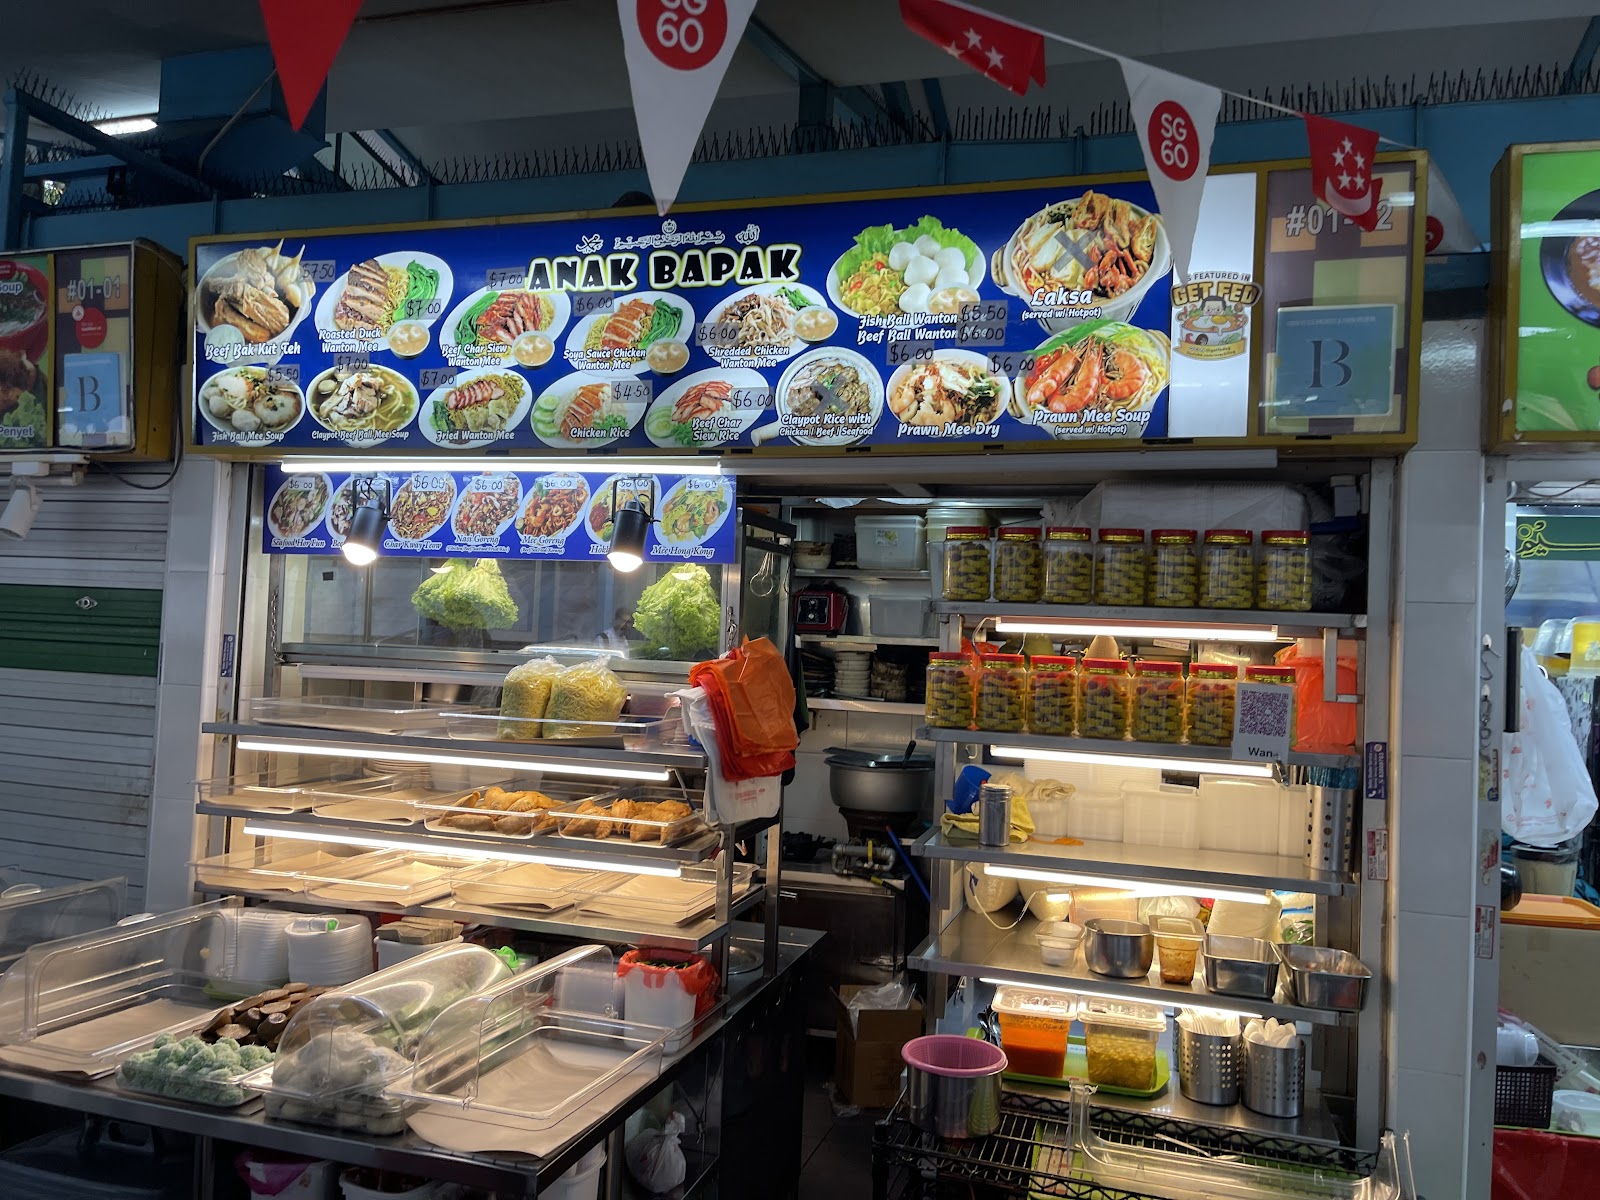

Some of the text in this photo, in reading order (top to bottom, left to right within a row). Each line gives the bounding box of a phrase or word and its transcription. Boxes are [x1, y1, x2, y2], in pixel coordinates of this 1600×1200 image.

[656, 10, 705, 54] 60
[1160, 112, 1187, 143] SG
[1160, 139, 1189, 169] 60
[1286, 199, 1394, 238] #01-2
[527, 247, 800, 292] ANAK BAPAK
[1194, 272, 1239, 281] FEATURED
[1240, 273, 1252, 282] IN
[0, 281, 23, 294] oup
[67, 275, 122, 302] #01-01
[1172, 281, 1260, 307] GET FED
[1031, 286, 1093, 307] Laksa
[575, 296, 613, 312] $6.00
[858, 314, 884, 329] Fish
[886, 312, 910, 329] Ball
[913, 312, 958, 326] Wanton
[1021, 311, 1053, 321] (served
[1068, 308, 1103, 320] Hotpot)
[319, 327, 382, 340] Roasted Duck
[696, 325, 738, 341] $6.00
[857, 329, 884, 345] Beef
[887, 328, 911, 344] Ball
[914, 327, 959, 342] Wanton
[205, 341, 301, 360] Beef Bak Kut Teh
[321, 341, 379, 353] Wanton Mee
[442, 342, 508, 357] Beef Char Siew
[563, 347, 647, 361] Soya Sauce Chicken
[708, 345, 790, 356] Shredded Chicken
[889, 343, 935, 364] $6.00
[448, 356, 501, 367] Wanton Mee
[577, 360, 631, 371] Wanton Mee
[720, 356, 777, 368] Wanton Mee
[1308, 339, 1352, 389] B
[78, 375, 101, 412] B
[732, 389, 774, 409] $6.00
[692, 416, 743, 430] Beef Char
[781, 412, 872, 427] Claypot Rice with
[1032, 408, 1151, 426] Prawn Mee Soup
[0, 425, 34, 439] Penyet
[212, 430, 285, 443] Fish Ball Mee Soup
[311, 430, 410, 441] Claypot Beef Ball Mee Soup
[435, 430, 515, 442] Fried Wanton Mee
[570, 427, 632, 438] Chicken Rice
[693, 429, 740, 441] Siew Rice
[779, 426, 874, 438] Chicken Beef Seafood
[897, 421, 1001, 439] Prawn Mee Dry
[1054, 425, 1084, 435] (served
[1097, 424, 1128, 435] Hotpot)
[413, 474, 446, 490] $6.00
[473, 479, 503, 491] $6.00
[272, 538, 297, 549] Seafood
[296, 538, 311, 548] Hor
[383, 540, 442, 552] Char Kway Teow
[455, 535, 500, 545] Nasi Goreng
[521, 535, 565, 546] Mee Goreng
[653, 546, 715, 558] Mee Hong Kong
